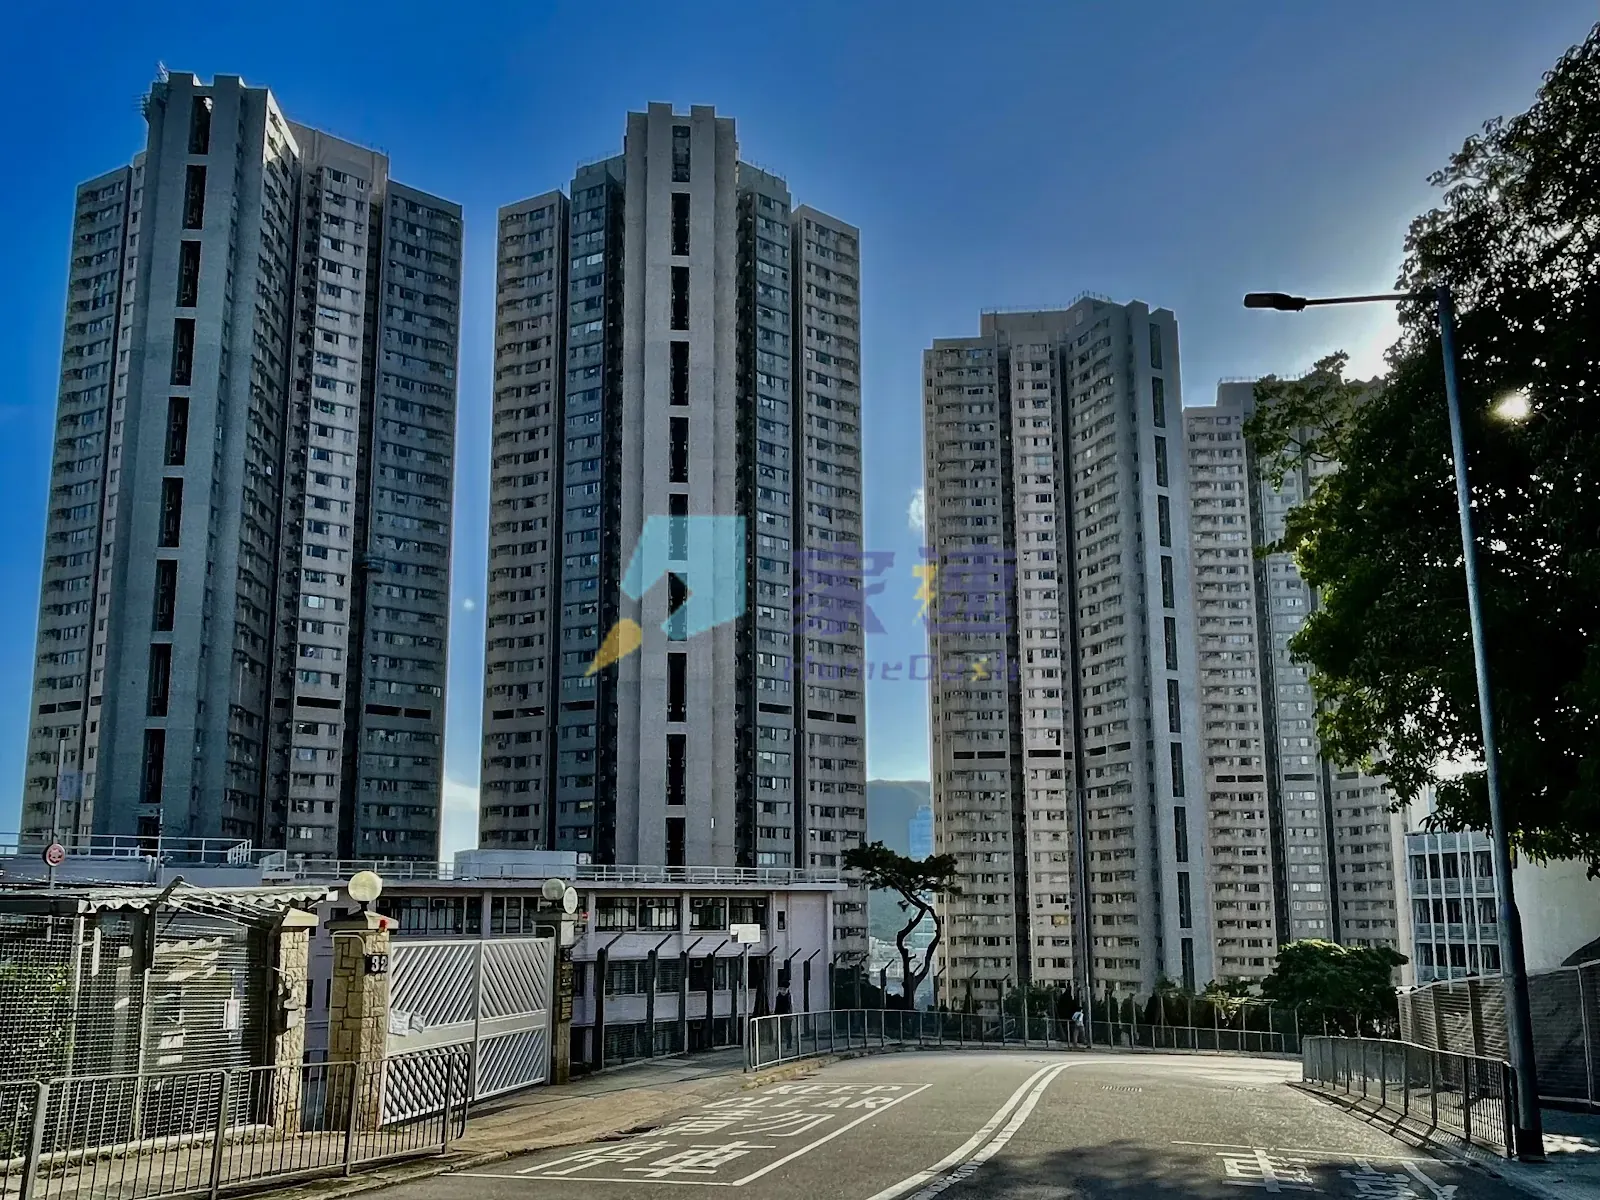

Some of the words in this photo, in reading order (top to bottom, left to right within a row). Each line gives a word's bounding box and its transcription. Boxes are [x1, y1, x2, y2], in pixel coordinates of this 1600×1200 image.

[371, 955, 388, 971] 32
[762, 1085, 903, 1096] KEEP
[702, 1096, 898, 1109] CLEAR
[639, 1109, 836, 1137] 請勿
[516, 1140, 777, 1179] 停車
